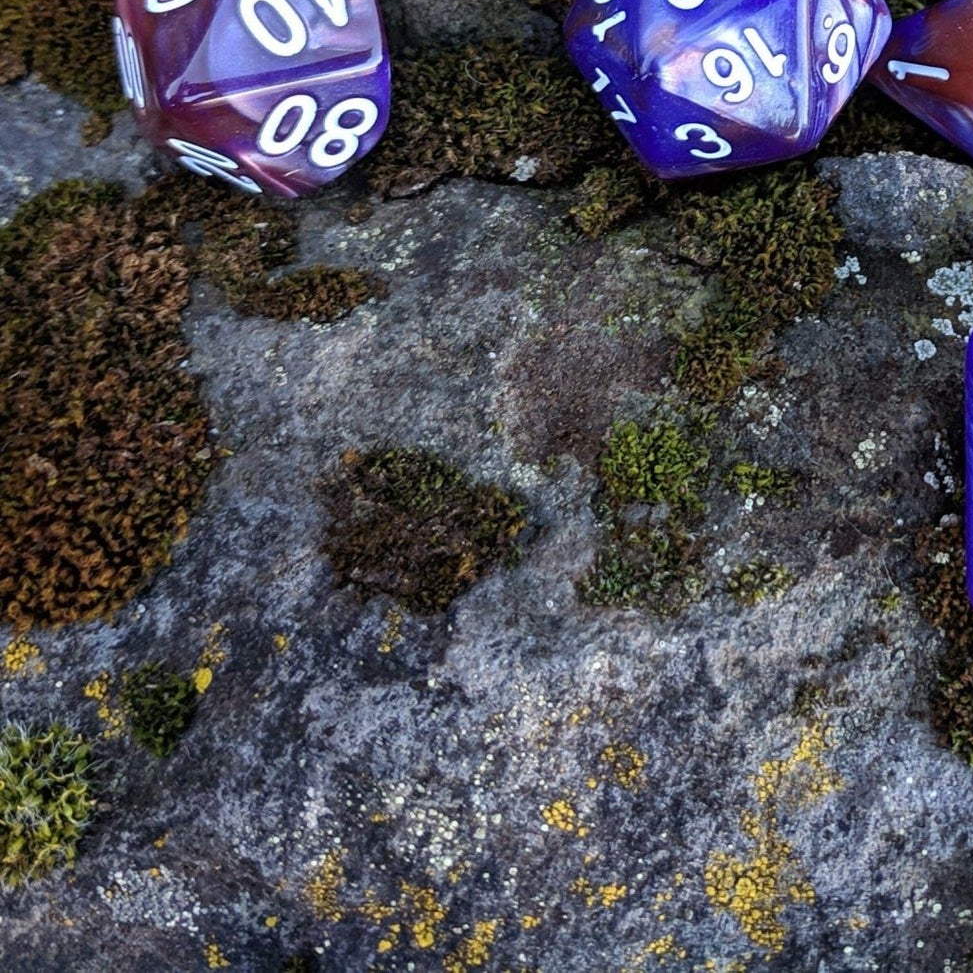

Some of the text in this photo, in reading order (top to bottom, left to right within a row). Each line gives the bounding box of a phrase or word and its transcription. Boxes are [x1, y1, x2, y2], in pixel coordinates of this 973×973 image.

[887, 59, 951, 81] 1
[257, 94, 379, 168] 80
[674, 123, 733, 160] 3
